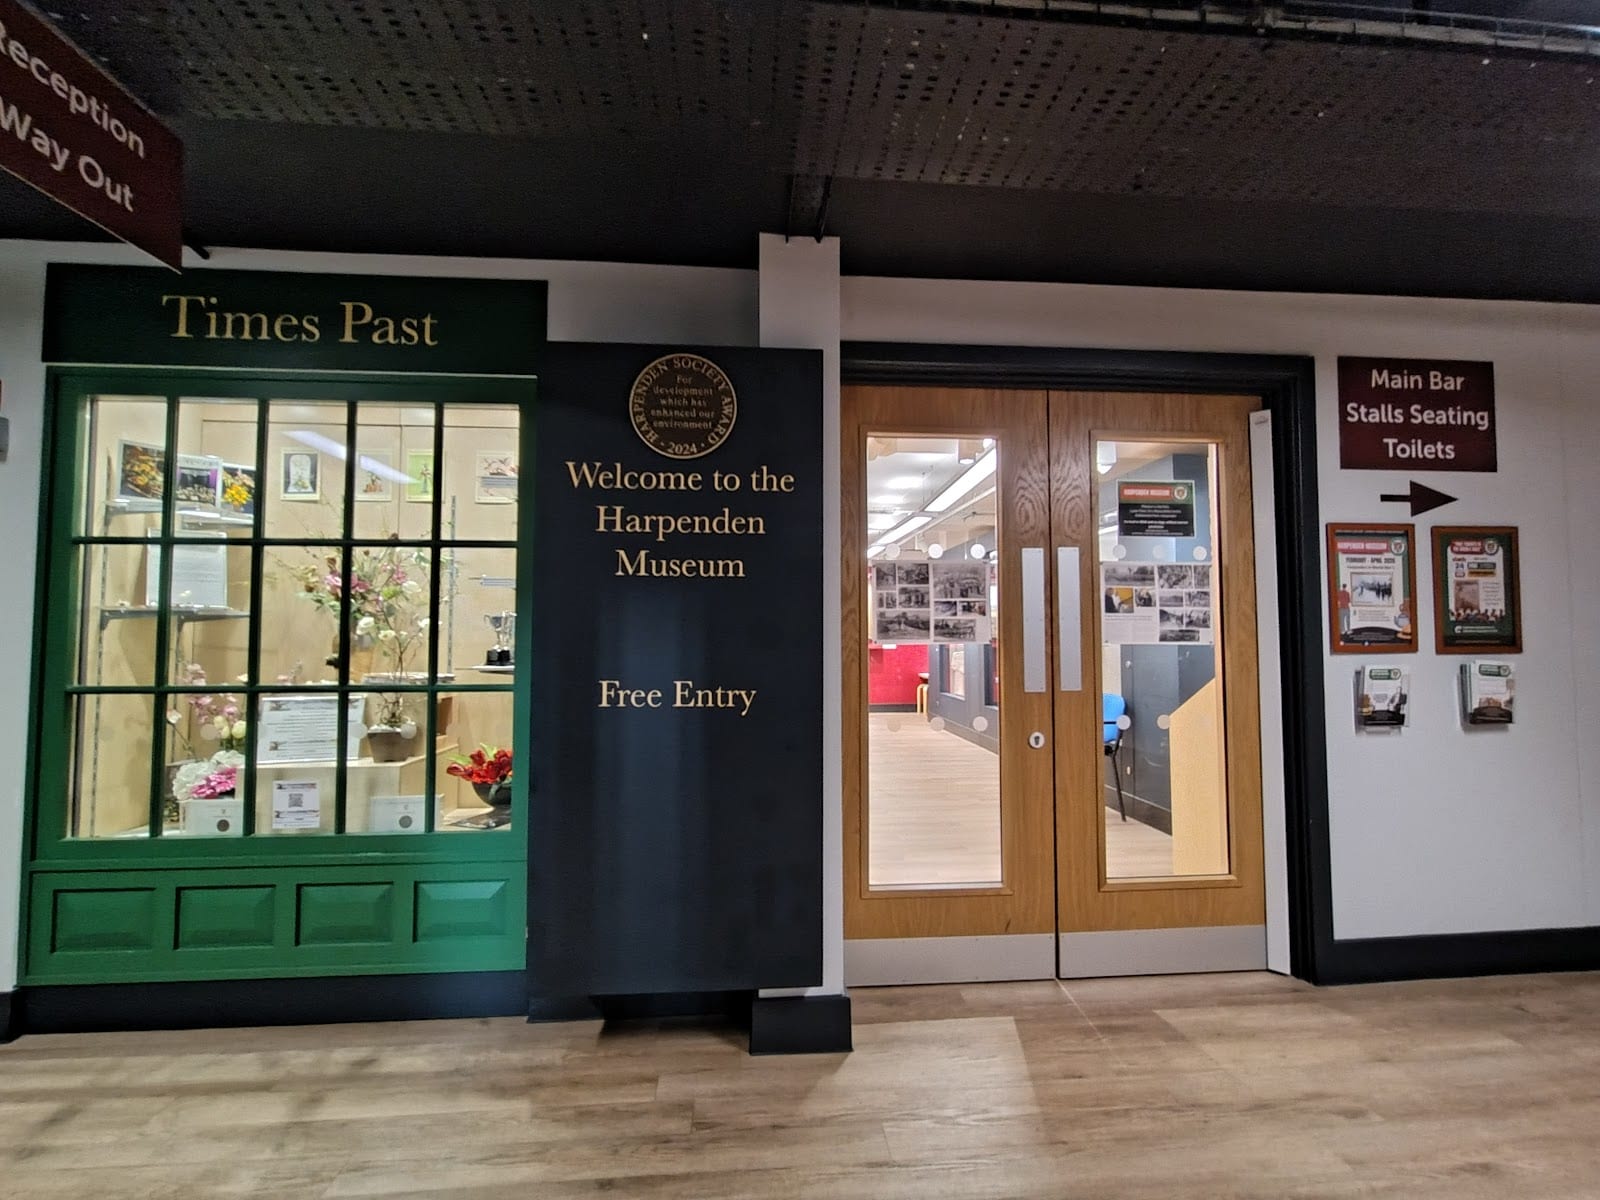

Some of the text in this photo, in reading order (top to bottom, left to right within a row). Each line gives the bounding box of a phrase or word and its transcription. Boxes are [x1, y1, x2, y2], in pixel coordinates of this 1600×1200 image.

[0, 96, 134, 212] Way Out
[162, 295, 438, 346] Times Past
[653, 386, 713, 396] development
[1371, 368, 1465, 390] Main Bar
[634, 358, 733, 444] HARPENDEN SOCIETY AWARD
[660, 398, 689, 406] which
[653, 420, 712, 429] environment
[1346, 402, 1489, 431] Stalls Seating
[667, 442, 698, 454] 2024
[1383, 438, 1455, 459] Toilets
[565, 461, 795, 492] Welcome to the
[596, 505, 766, 542] Harpenden
[615, 549, 746, 577] Museum
[598, 679, 757, 717] Free Entry
